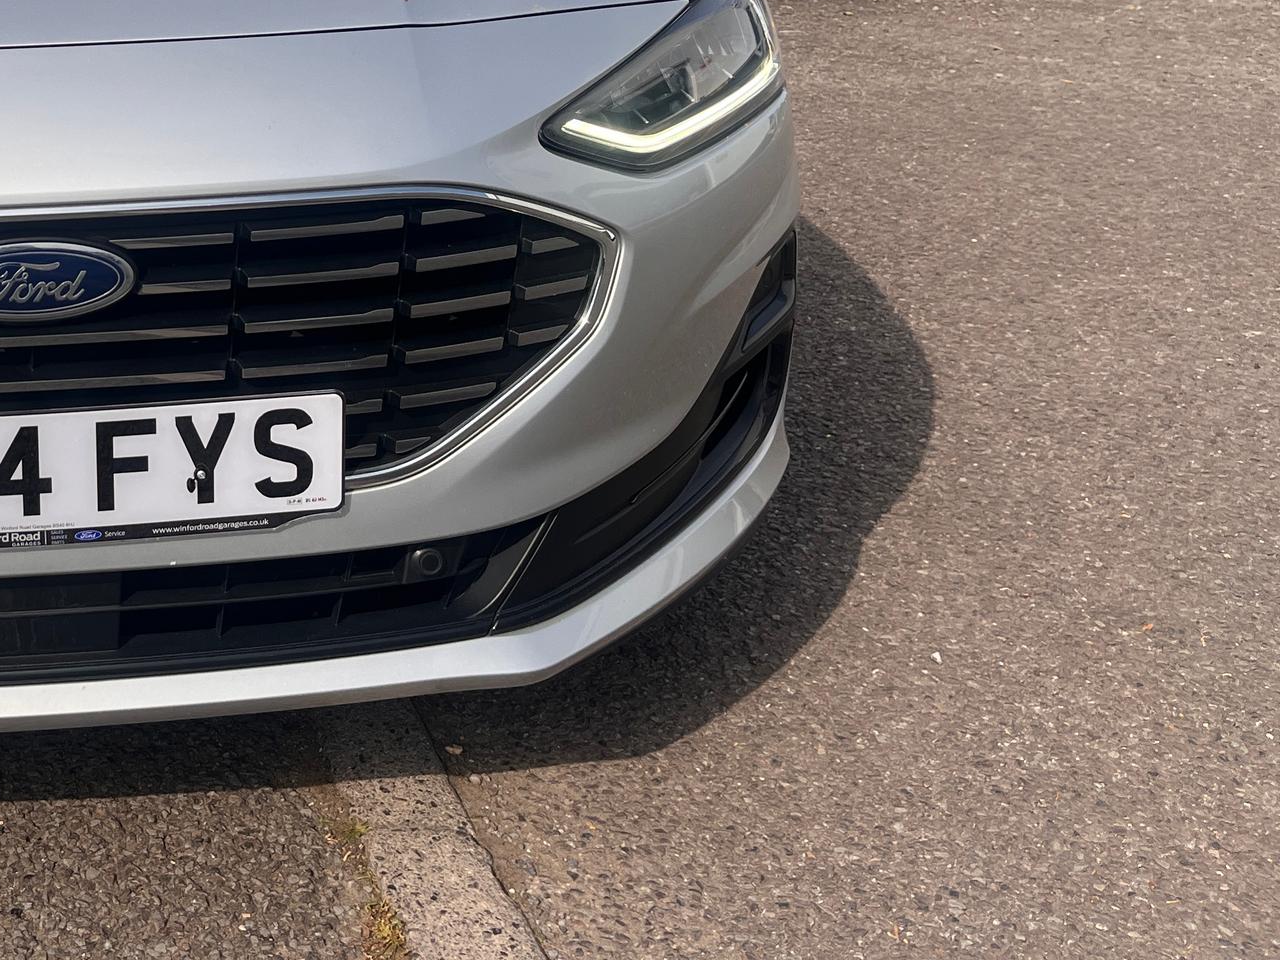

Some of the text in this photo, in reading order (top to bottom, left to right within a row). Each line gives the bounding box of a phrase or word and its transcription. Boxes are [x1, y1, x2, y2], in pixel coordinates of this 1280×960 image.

[95, 407, 315, 512] FYS
[152, 518, 269, 534] www.winfordroadgarages.co.uk
[11, 531, 40, 542] Road
